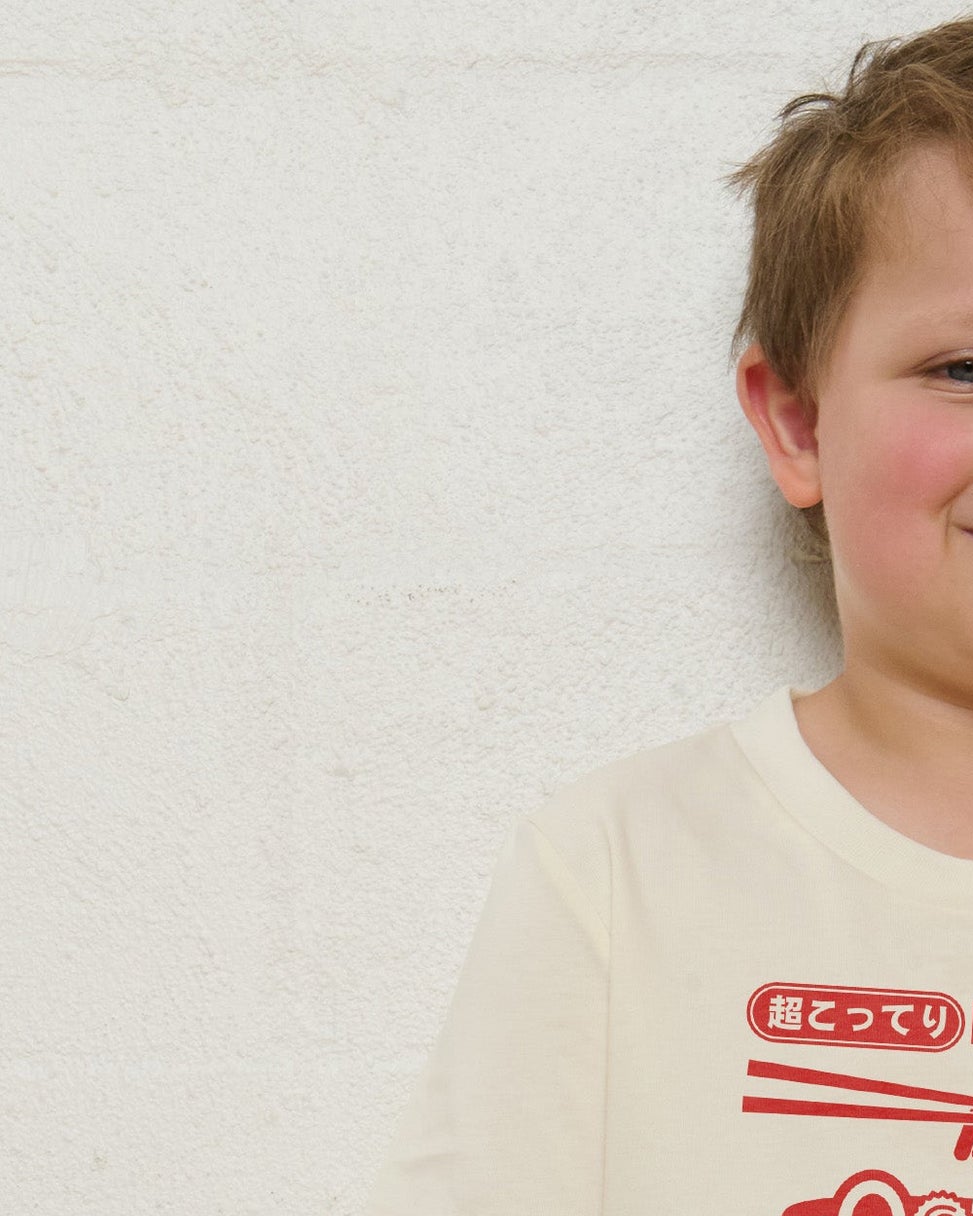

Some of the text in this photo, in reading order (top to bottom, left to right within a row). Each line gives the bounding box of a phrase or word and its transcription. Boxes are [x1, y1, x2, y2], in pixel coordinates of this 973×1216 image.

[767, 994, 947, 1039] 超こってり
